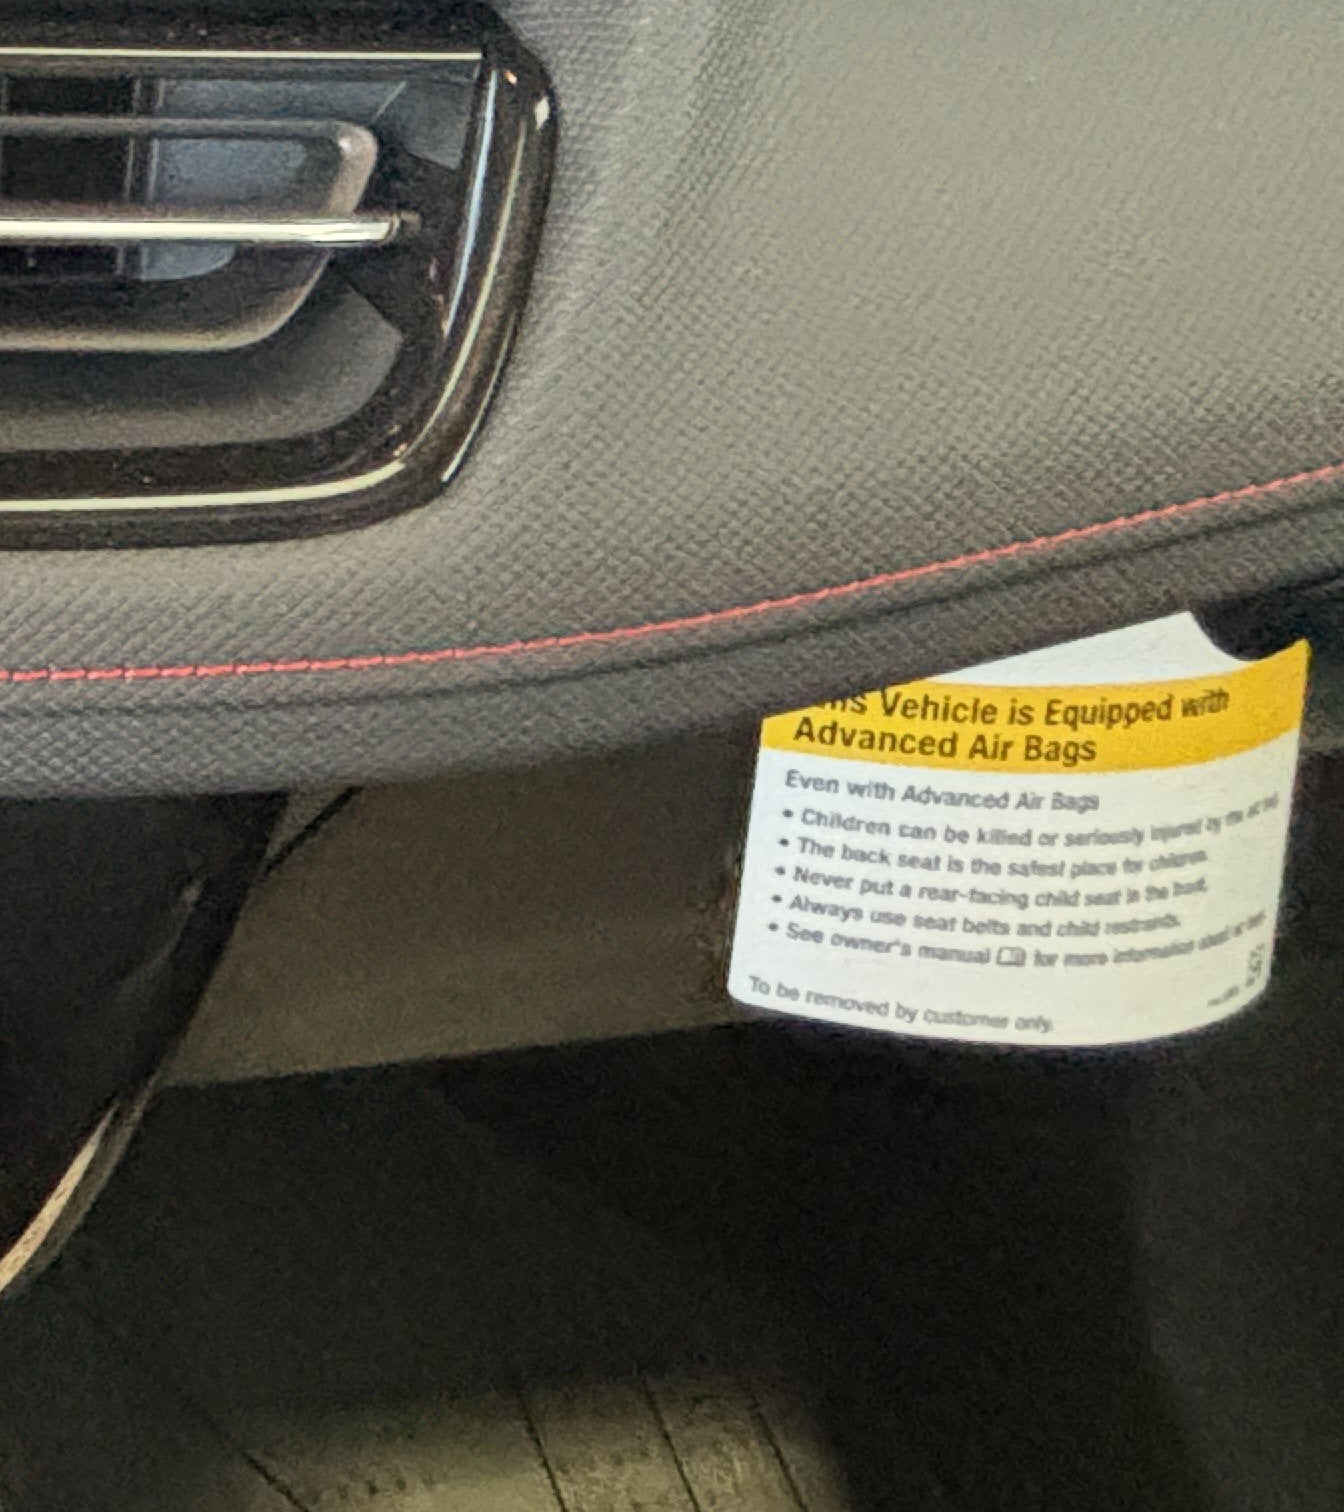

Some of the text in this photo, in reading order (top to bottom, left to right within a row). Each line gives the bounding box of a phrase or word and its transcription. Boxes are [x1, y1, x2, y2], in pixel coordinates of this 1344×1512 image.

[879, 688, 996, 725] Vehicle
[1008, 698, 1034, 726] is
[1045, 693, 1174, 731] Equipped
[1181, 688, 1230, 718] with
[793, 716, 1097, 767] Advanced Air Bags
[785, 769, 1099, 814] Even with Advanced Air Bags
[801, 807, 891, 836] Children
[899, 823, 937, 841] can
[944, 824, 970, 844] be
[1038, 833, 1059, 846] or
[797, 837, 835, 859] The
[841, 844, 891, 866] back
[897, 854, 941, 872] seat
[947, 855, 964, 873] is
[971, 858, 1002, 876] the
[793, 865, 854, 890] Never
[859, 878, 894, 896] put
[899, 884, 912, 898] a
[918, 886, 1029, 910] rear-facing
[789, 894, 863, 922] Always
[870, 910, 906, 926] use
[913, 914, 958, 931] seat
[962, 916, 1010, 935] belts
[1017, 920, 1052, 936] and
[786, 922, 824, 944] See
[830, 932, 912, 957] owner's
[918, 945, 991, 965] manual
[749, 974, 772, 996] To
[776, 980, 800, 1002] be
[805, 990, 889, 1018] removed
[895, 1001, 918, 1023] by
[922, 1008, 1009, 1029] customer
